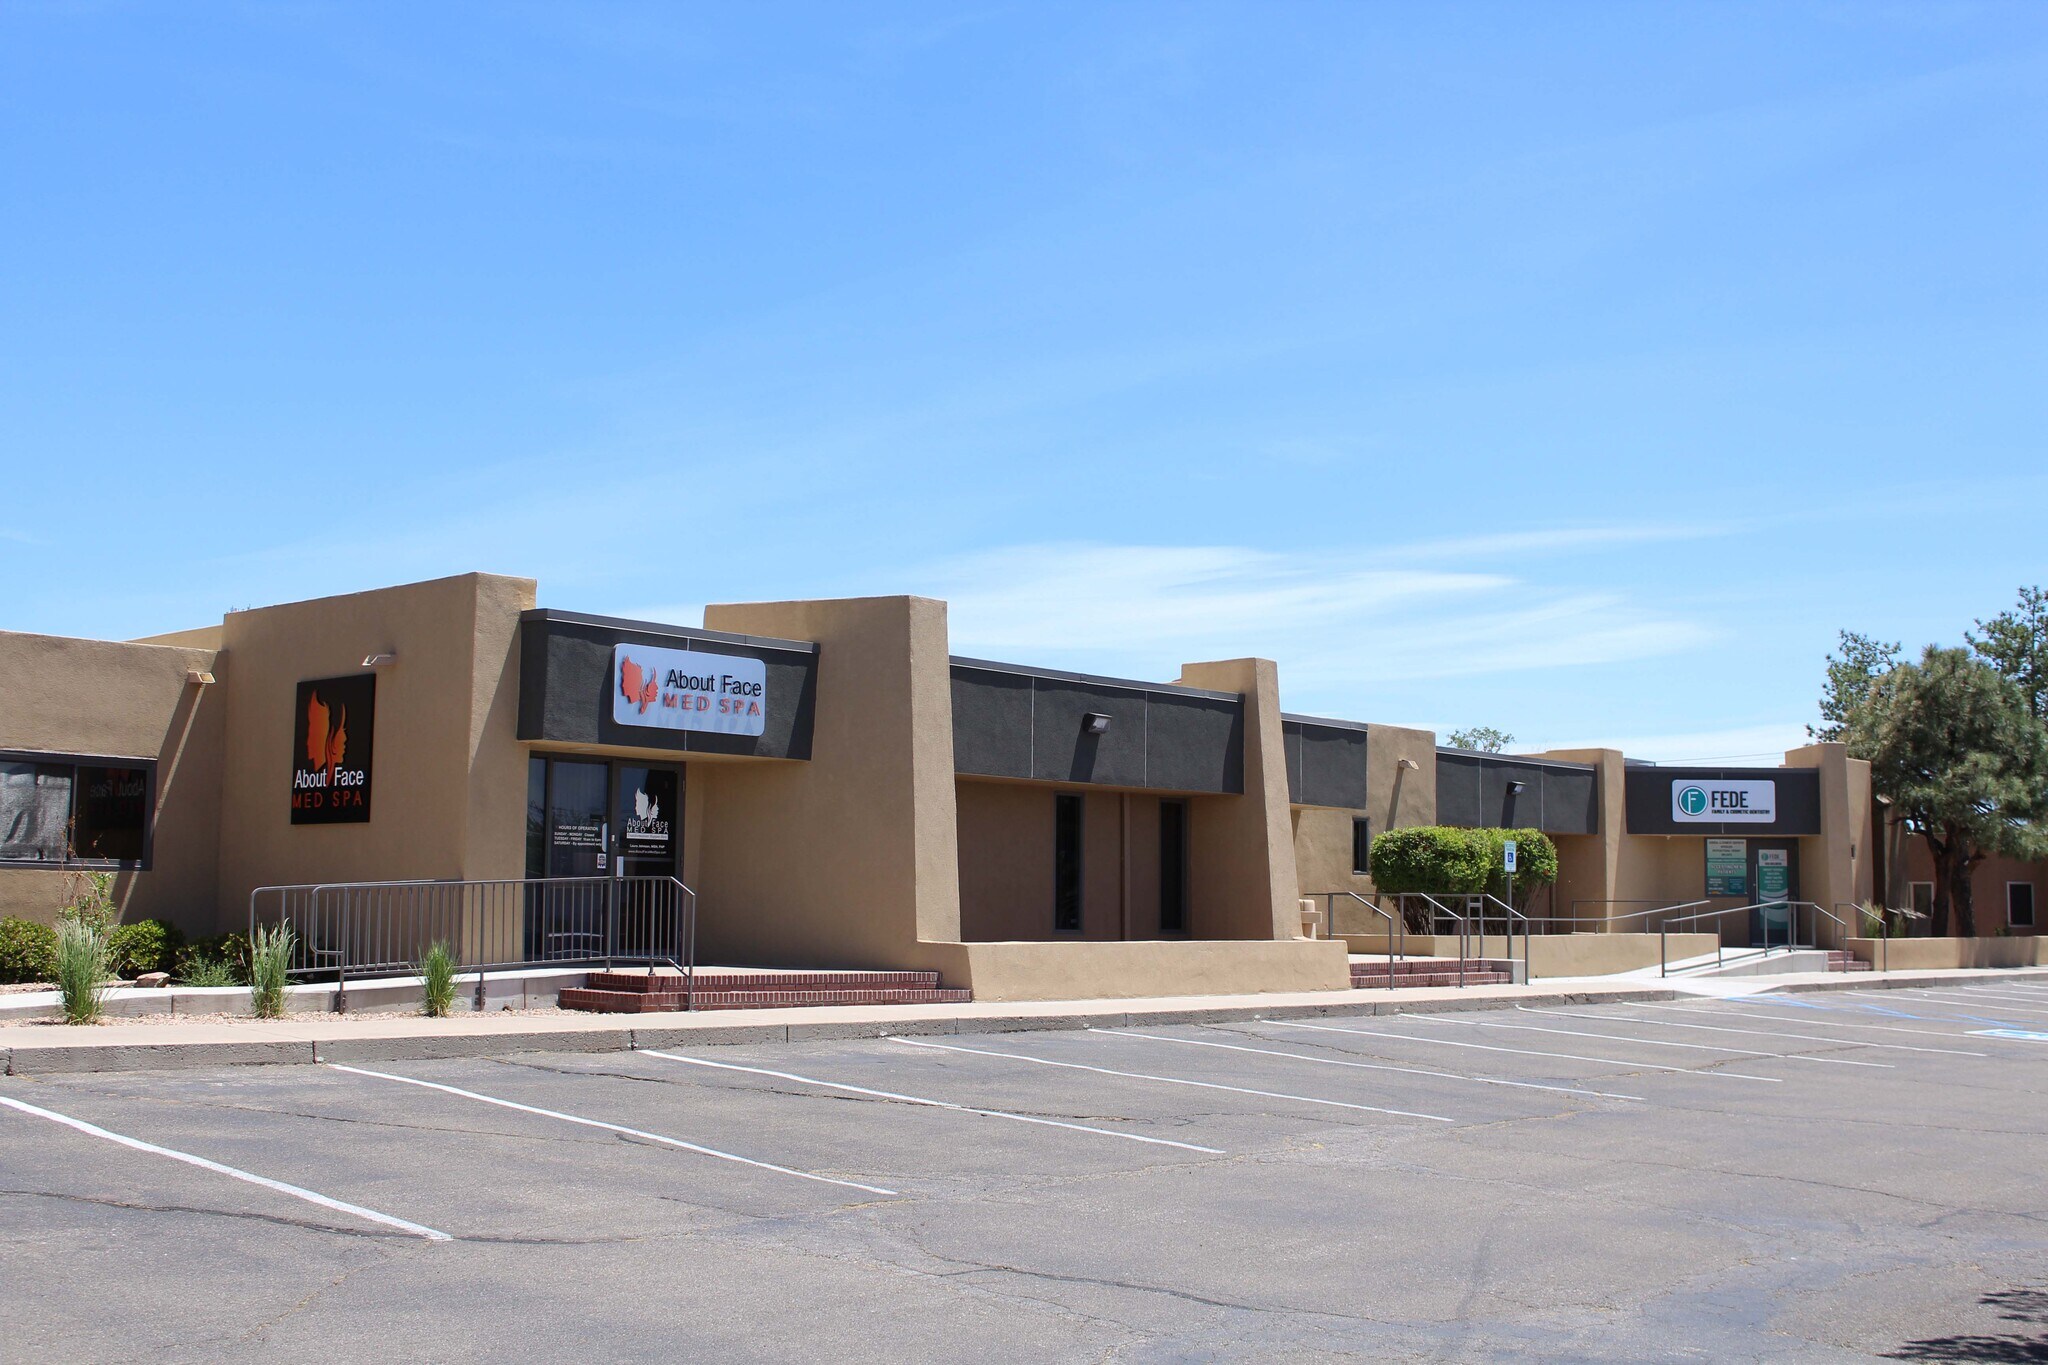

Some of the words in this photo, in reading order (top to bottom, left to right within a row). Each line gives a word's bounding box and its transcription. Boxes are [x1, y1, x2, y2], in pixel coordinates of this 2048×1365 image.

[666, 669, 715, 692] About
[722, 675, 762, 697] Face
[663, 693, 711, 712] MED
[719, 697, 761, 716] SPA
[294, 769, 327, 788] About
[334, 767, 364, 786] Face
[292, 792, 324, 809] MED
[332, 790, 363, 807] SPA
[1711, 791, 1749, 808] FEDE
[627, 818, 648, 827] About
[652, 819, 669, 828] Face
